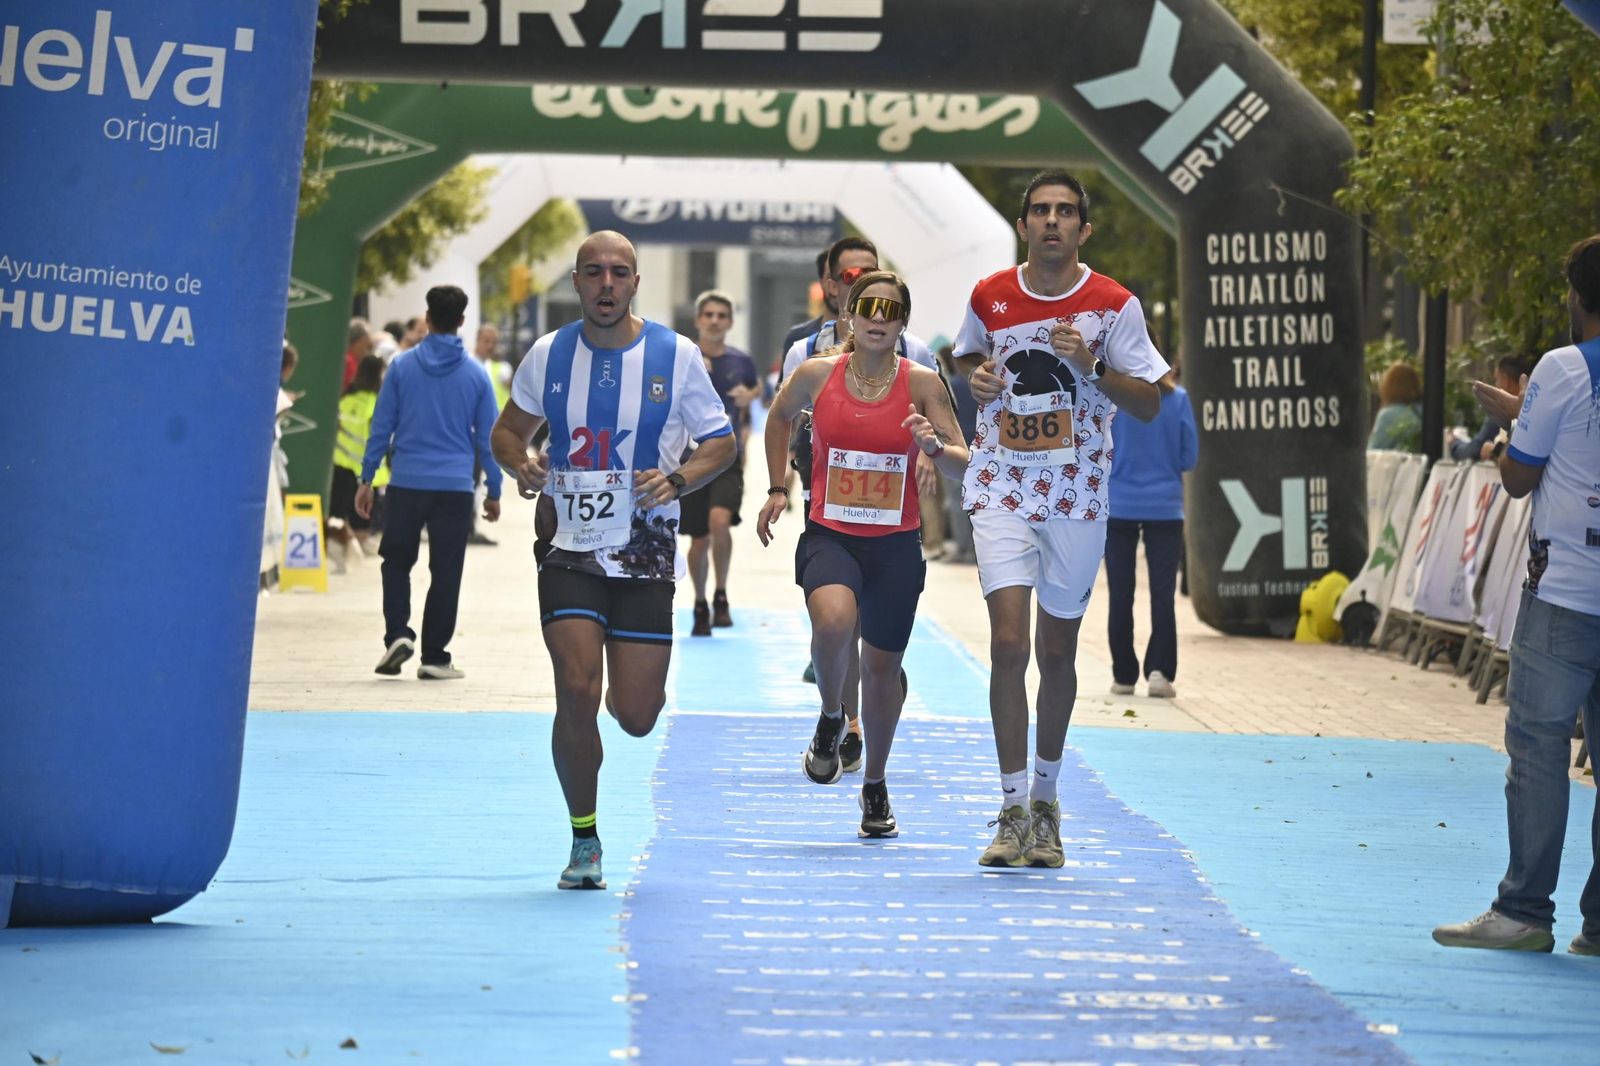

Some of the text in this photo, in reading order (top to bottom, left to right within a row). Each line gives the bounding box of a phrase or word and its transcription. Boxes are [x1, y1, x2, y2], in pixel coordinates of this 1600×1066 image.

[103, 113, 219, 151] original
[1206, 230, 1328, 265] CICLISMO
[0, 255, 202, 295] Ayuntamiento de
[1209, 267, 1326, 306] TRIATLÓN
[0, 289, 195, 346] HUELVA
[1204, 313, 1335, 348] ATLETISMO
[1233, 356, 1306, 389] TRAIL
[1006, 412, 1059, 441] 386
[1202, 396, 1341, 432] CANICROSS
[1012, 452, 1048, 461] Huelva
[838, 470, 891, 498] 514
[562, 491, 615, 522] 752
[842, 507, 877, 519] Huelva
[289, 532, 318, 560] 21
